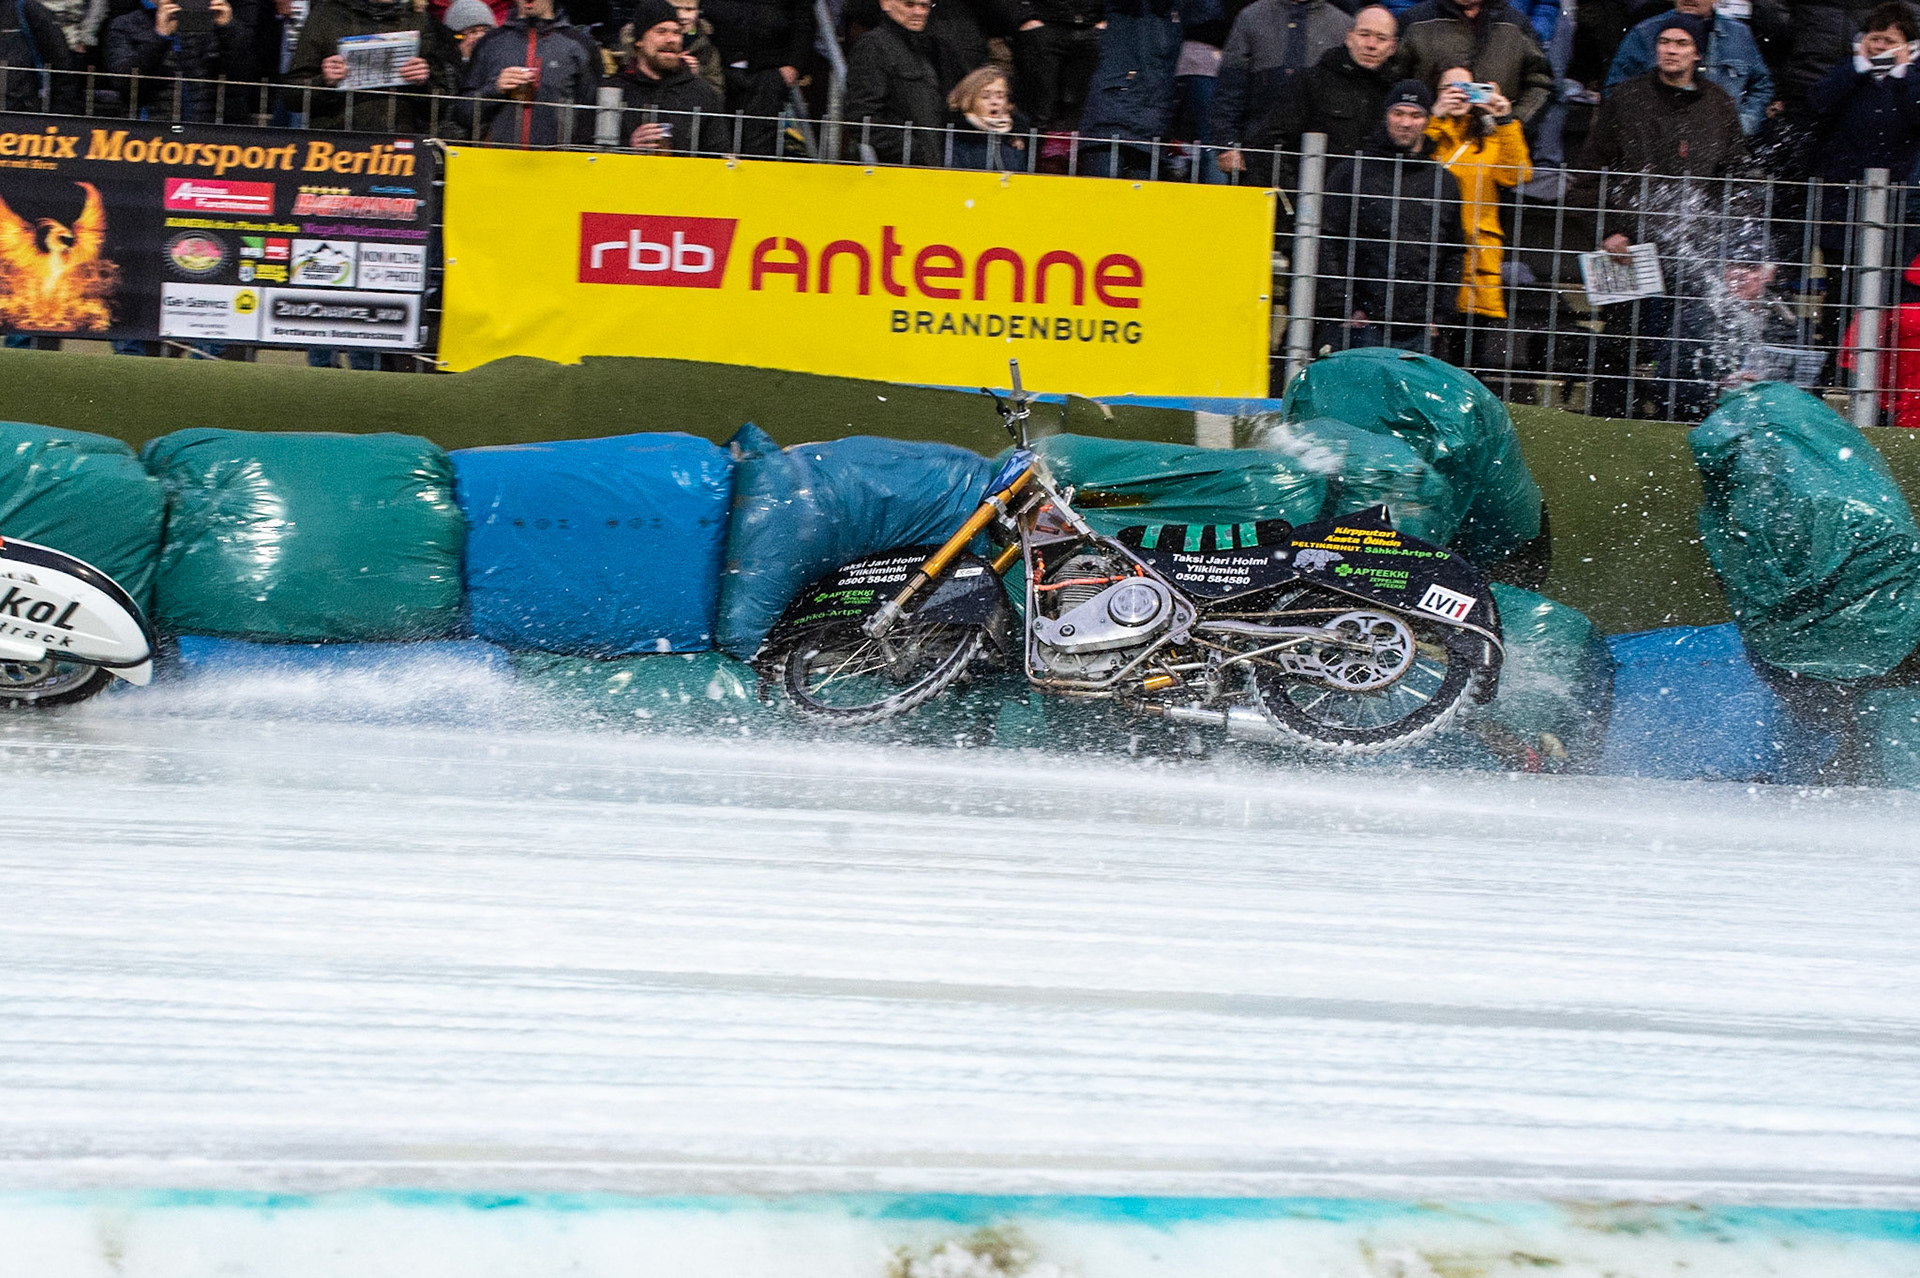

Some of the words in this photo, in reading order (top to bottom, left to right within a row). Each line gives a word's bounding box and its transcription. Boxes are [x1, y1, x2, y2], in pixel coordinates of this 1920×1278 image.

[84, 129, 297, 176] Motorsport
[302, 141, 416, 176] Berlin
[590, 229, 715, 274] rbb
[750, 225, 1145, 309] Antenne
[890, 309, 1144, 344] BRANDENBURG
[1334, 527, 1397, 538] Kirpputori
[1172, 554, 1204, 563] Taksi
[1206, 556, 1230, 565] Jari
[1232, 557, 1268, 565] Holmi
[1435, 551, 1451, 560] Oy
[867, 559, 891, 568] Jari
[892, 555, 926, 565] Holmi
[1175, 573, 1205, 582] 0500
[1207, 575, 1251, 584] 584580
[1353, 568, 1409, 579] APTEEKKI
[838, 576, 866, 586] 0500
[866, 574, 907, 584] 584580
